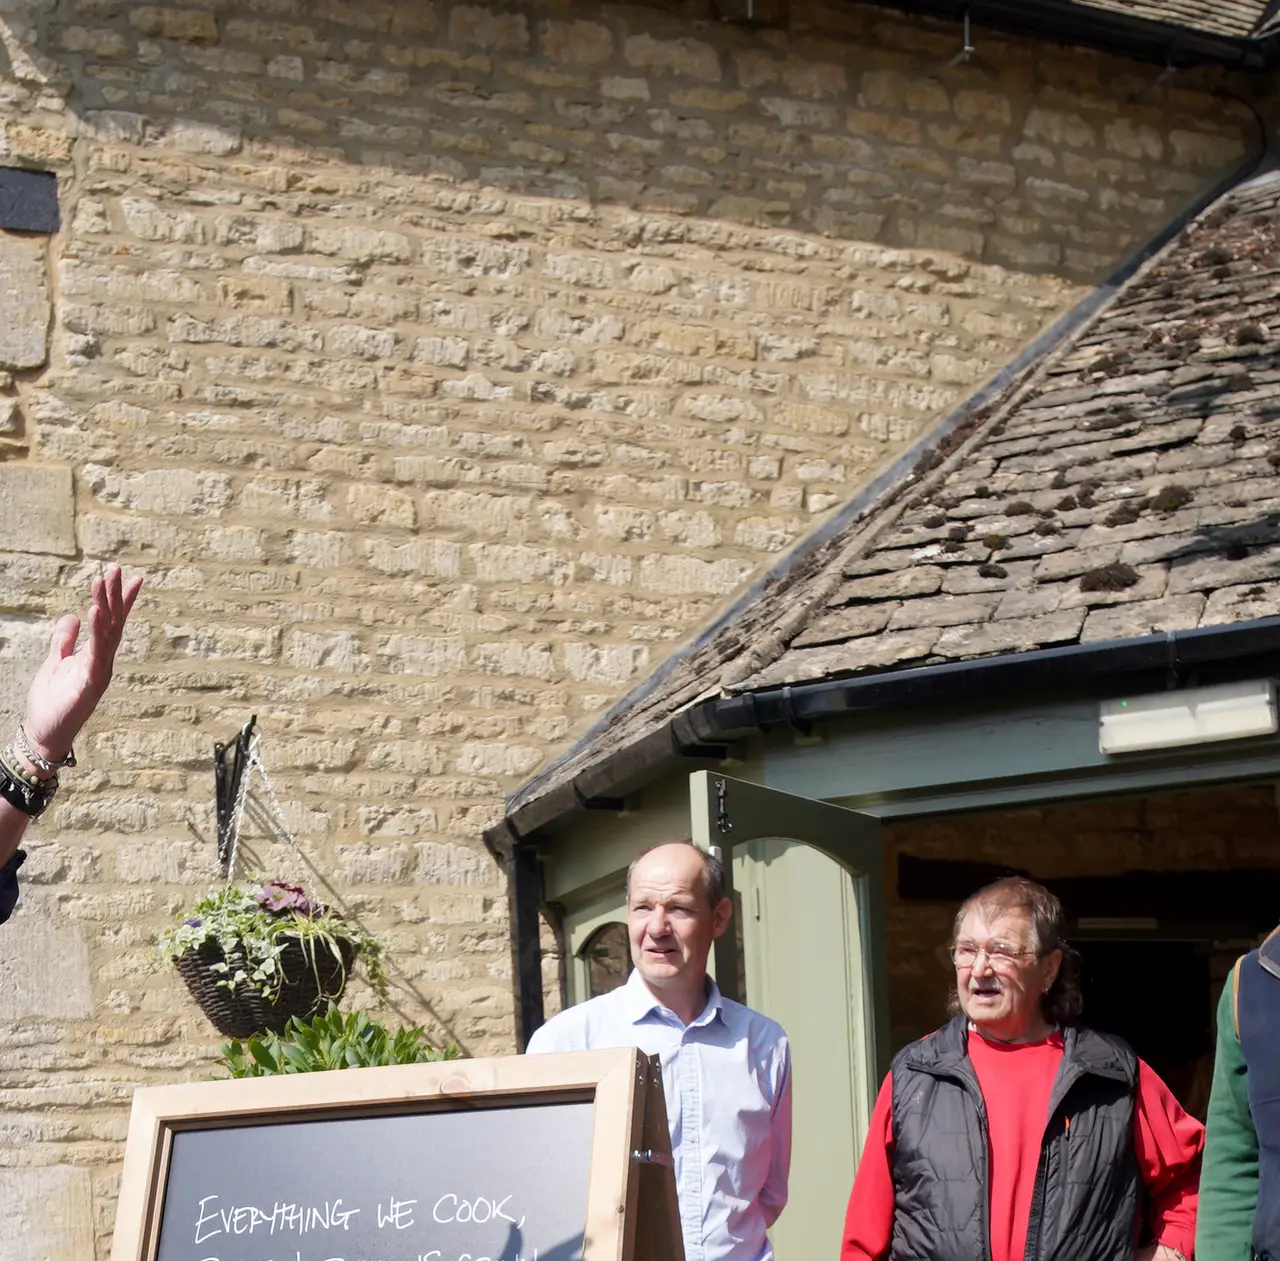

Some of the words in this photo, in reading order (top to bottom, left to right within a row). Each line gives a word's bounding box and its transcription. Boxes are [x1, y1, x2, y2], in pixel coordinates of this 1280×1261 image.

[194, 1194, 361, 1245] EVERYTHING
[377, 1196, 418, 1230] WE
[432, 1193, 526, 1229] COOK,
